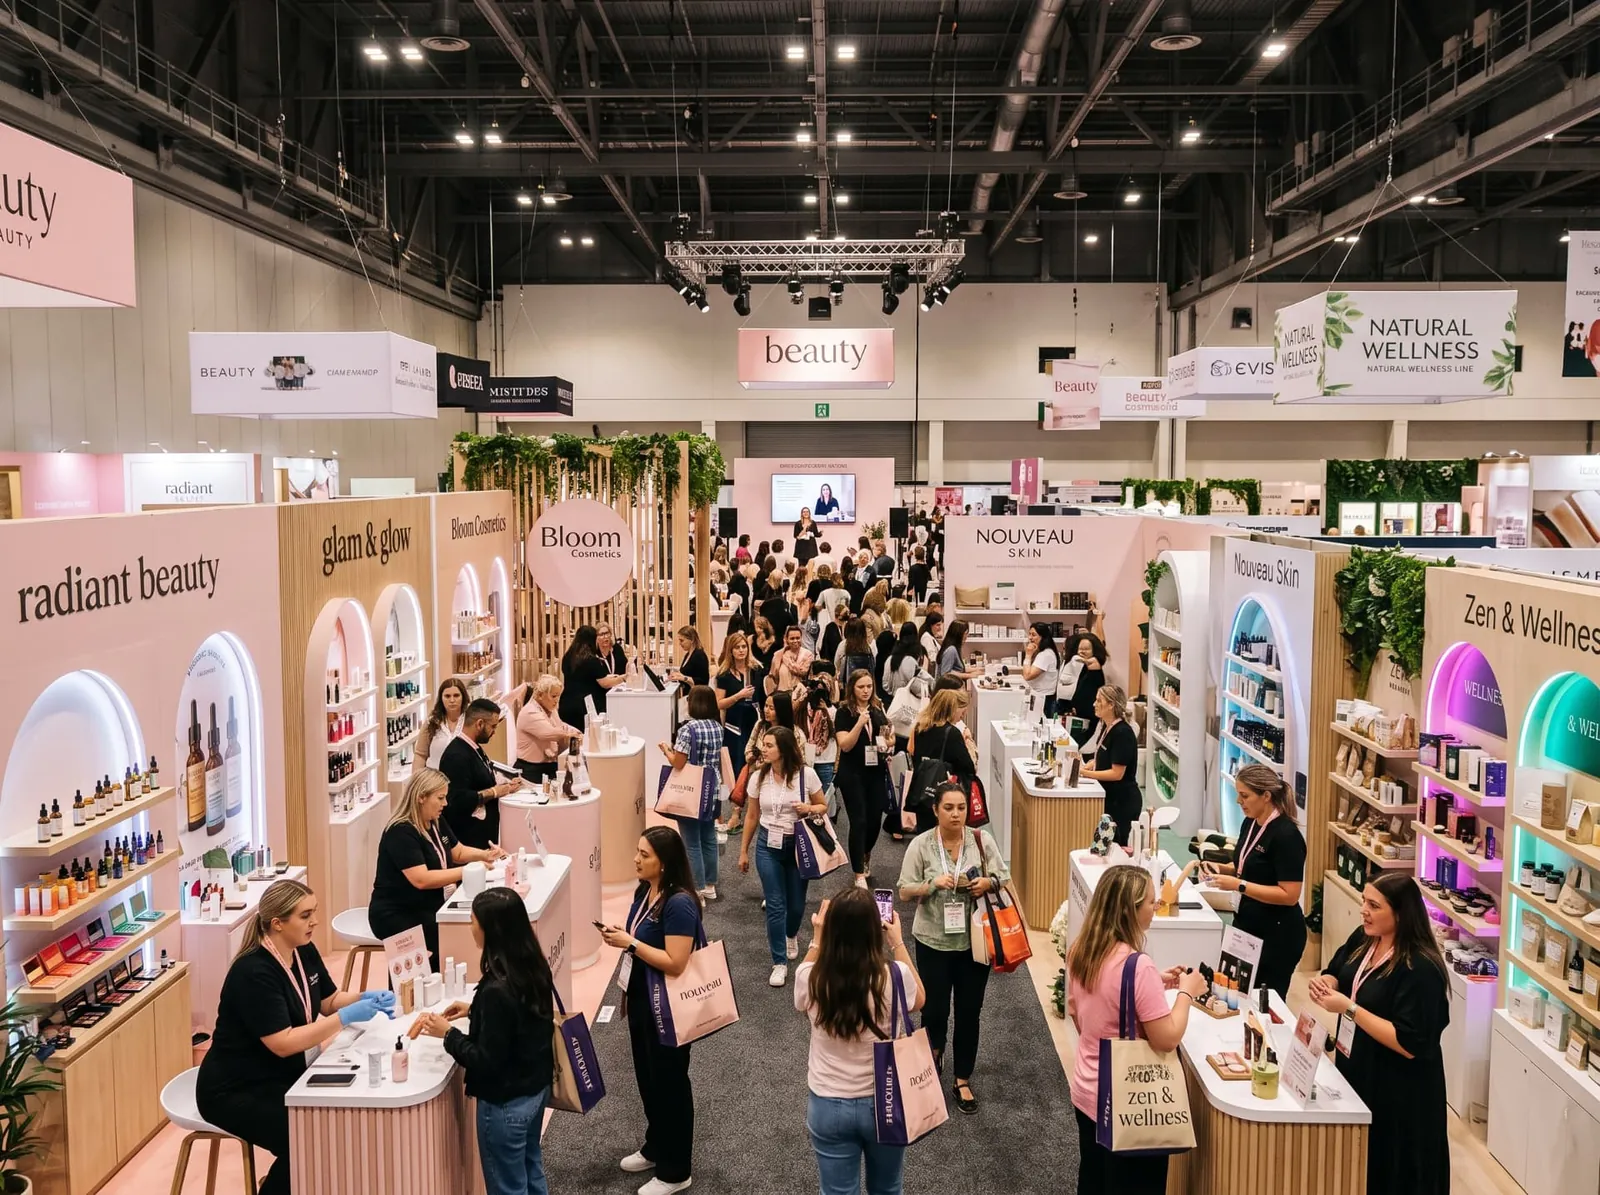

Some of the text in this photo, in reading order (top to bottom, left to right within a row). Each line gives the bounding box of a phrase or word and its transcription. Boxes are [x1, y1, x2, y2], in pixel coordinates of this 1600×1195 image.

[0, 172, 57, 238] uty
[1284, 324, 1316, 348] NATURAL
[1370, 318, 1473, 337] NATURAL
[765, 335, 867, 371] beauty
[1281, 345, 1318, 369] WELLNESS
[1362, 341, 1479, 360] WELLNESS
[200, 368, 255, 378] BEAUTY
[1367, 365, 1474, 373] NATURAL WELLNESS LINE
[1055, 380, 1098, 394] Beauty
[165, 481, 213, 494] radiant
[451, 513, 506, 540] Bloom Cosmetics
[976, 528, 1074, 544] NOUVEAU
[541, 525, 621, 548] Bloom
[322, 518, 411, 576] glam & glow
[571, 549, 621, 558] Cosmetics
[1008, 548, 1042, 558] SKIN
[1234, 552, 1300, 588] Nouveau Skin
[18, 554, 220, 623] radiant beauty
[1464, 594, 1600, 655] Zen & Wellnes
[1567, 714, 1577, 732] &
[680, 977, 723, 1001] nouveau
[1128, 1086, 1175, 1105] zen &
[1119, 1108, 1189, 1127] wellness
